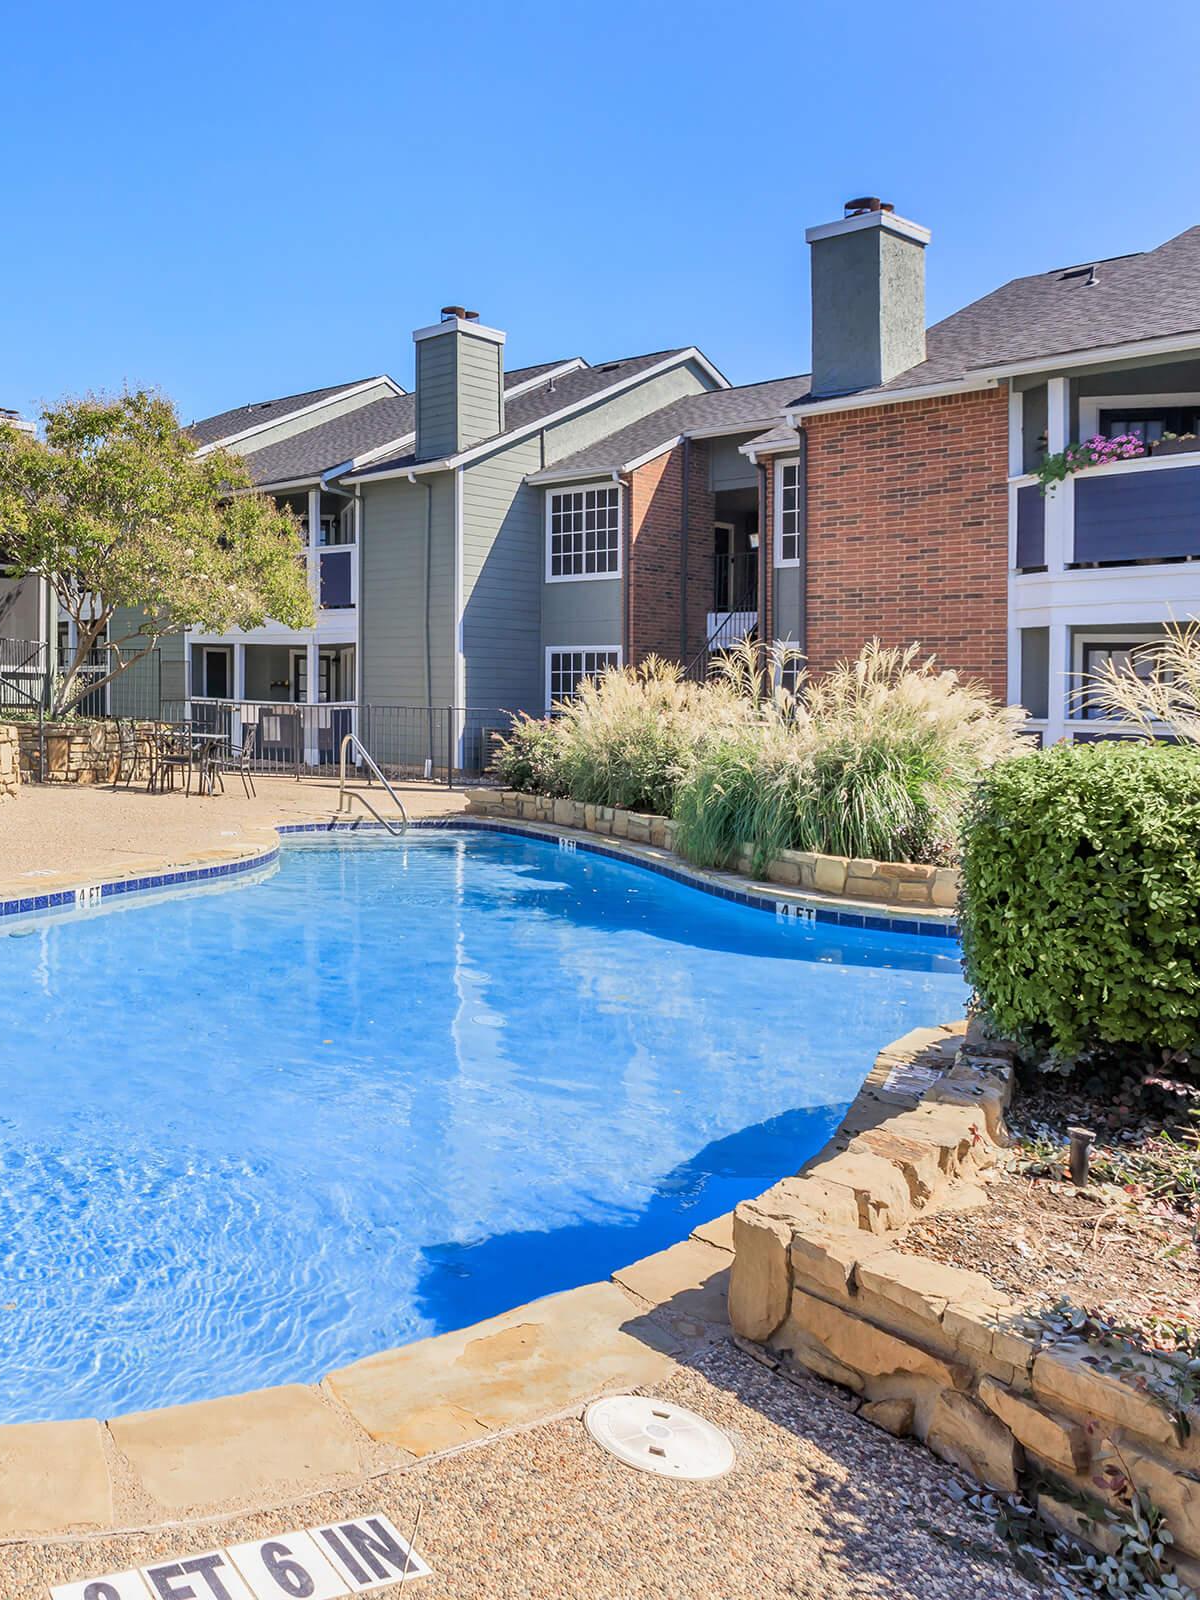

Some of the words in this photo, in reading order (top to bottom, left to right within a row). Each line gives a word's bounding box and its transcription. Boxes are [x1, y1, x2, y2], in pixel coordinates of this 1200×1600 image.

[90, 886, 100, 898] FT
[781, 904, 789, 915] 4
[797, 906, 814, 920] FT
[147, 1554, 232, 1600] FT
[260, 1541, 315, 1598] 6
[319, 1518, 420, 1584] IN
